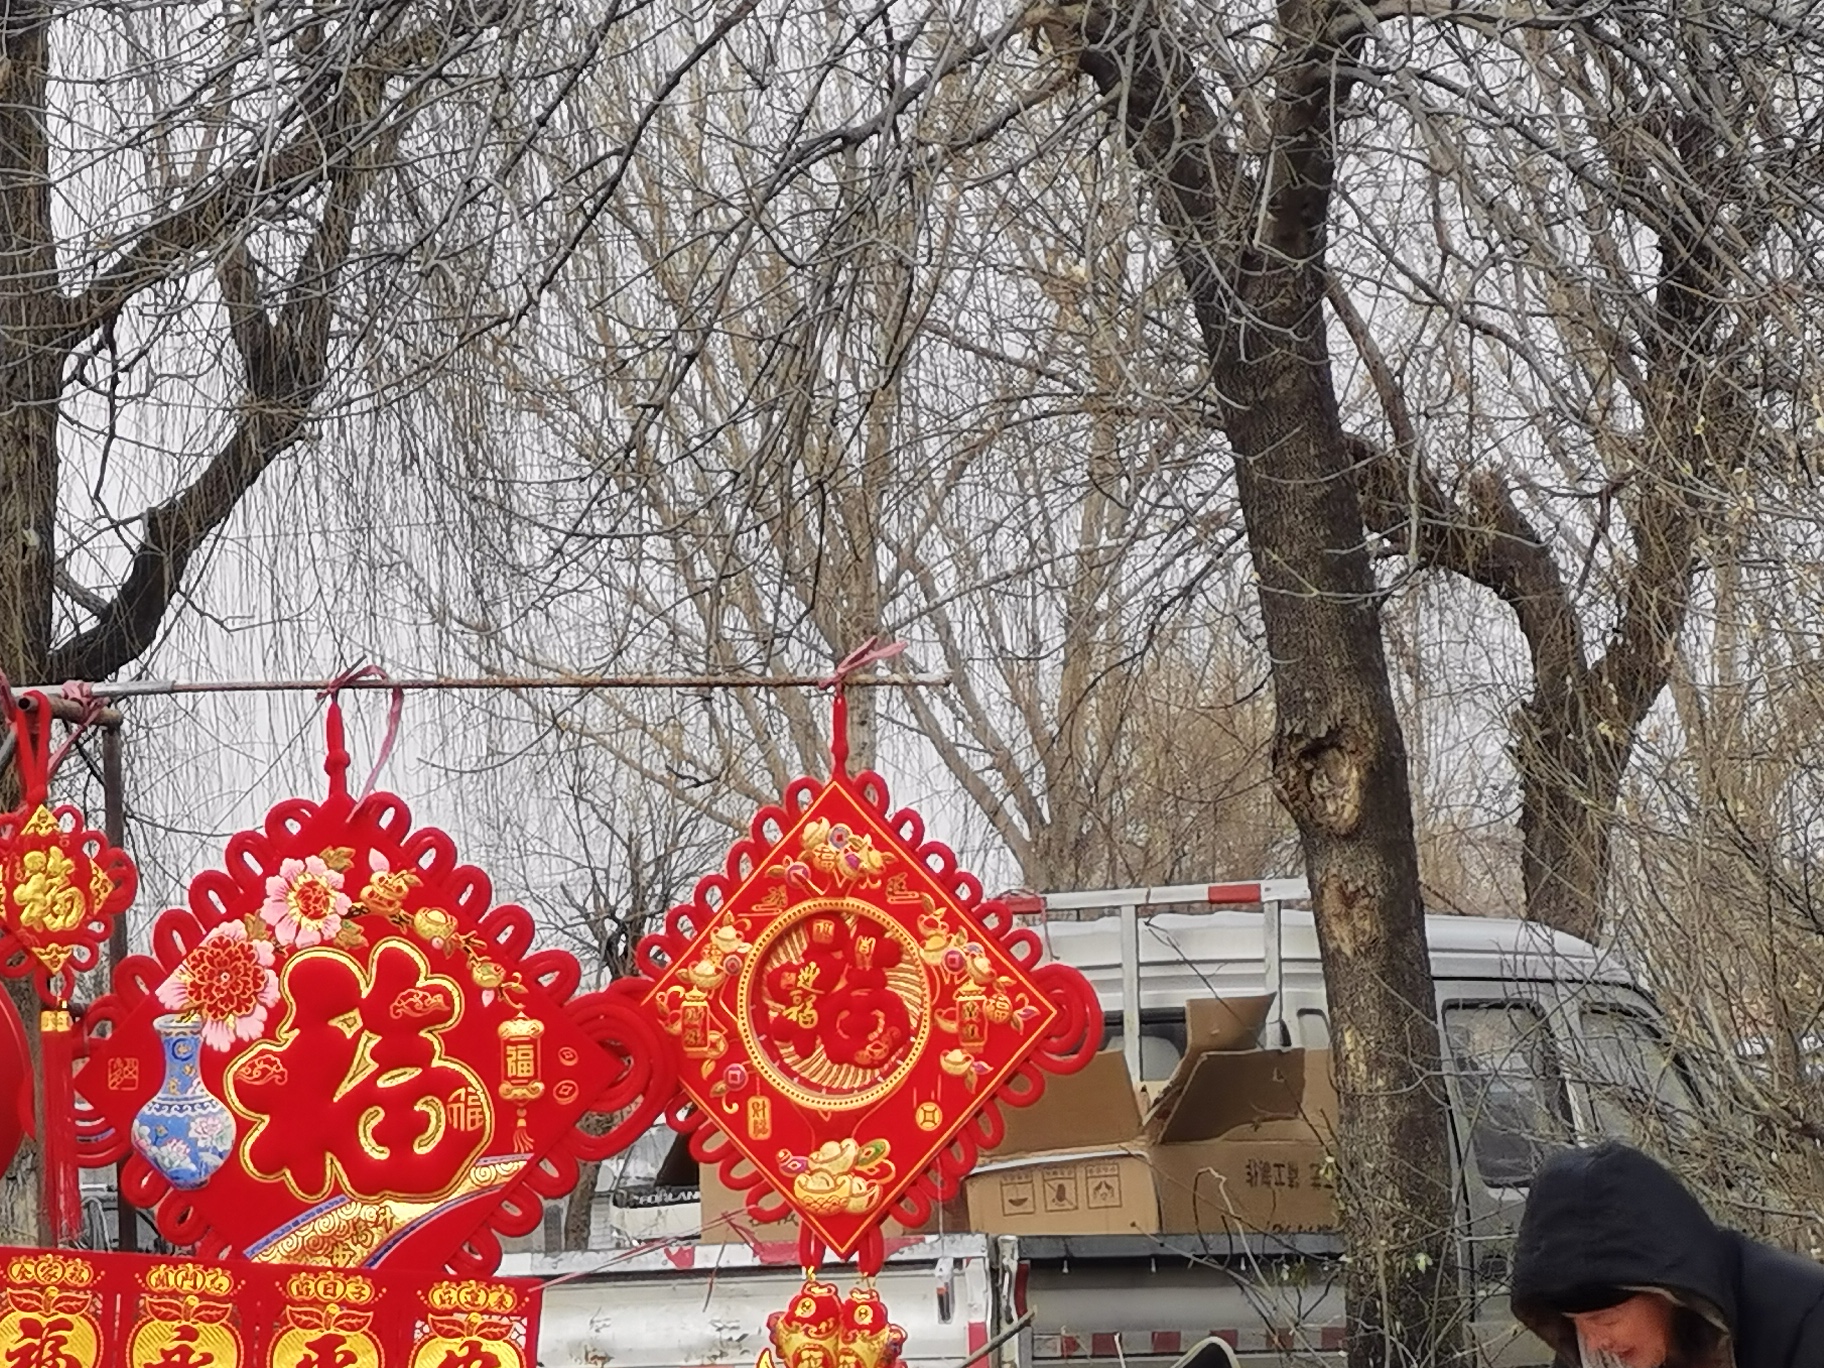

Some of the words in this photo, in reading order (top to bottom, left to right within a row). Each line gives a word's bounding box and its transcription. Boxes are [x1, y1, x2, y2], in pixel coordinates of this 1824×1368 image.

[13, 845, 86, 932] 福
[224, 937, 494, 1203] 福
[505, 1045, 535, 1079] 福
